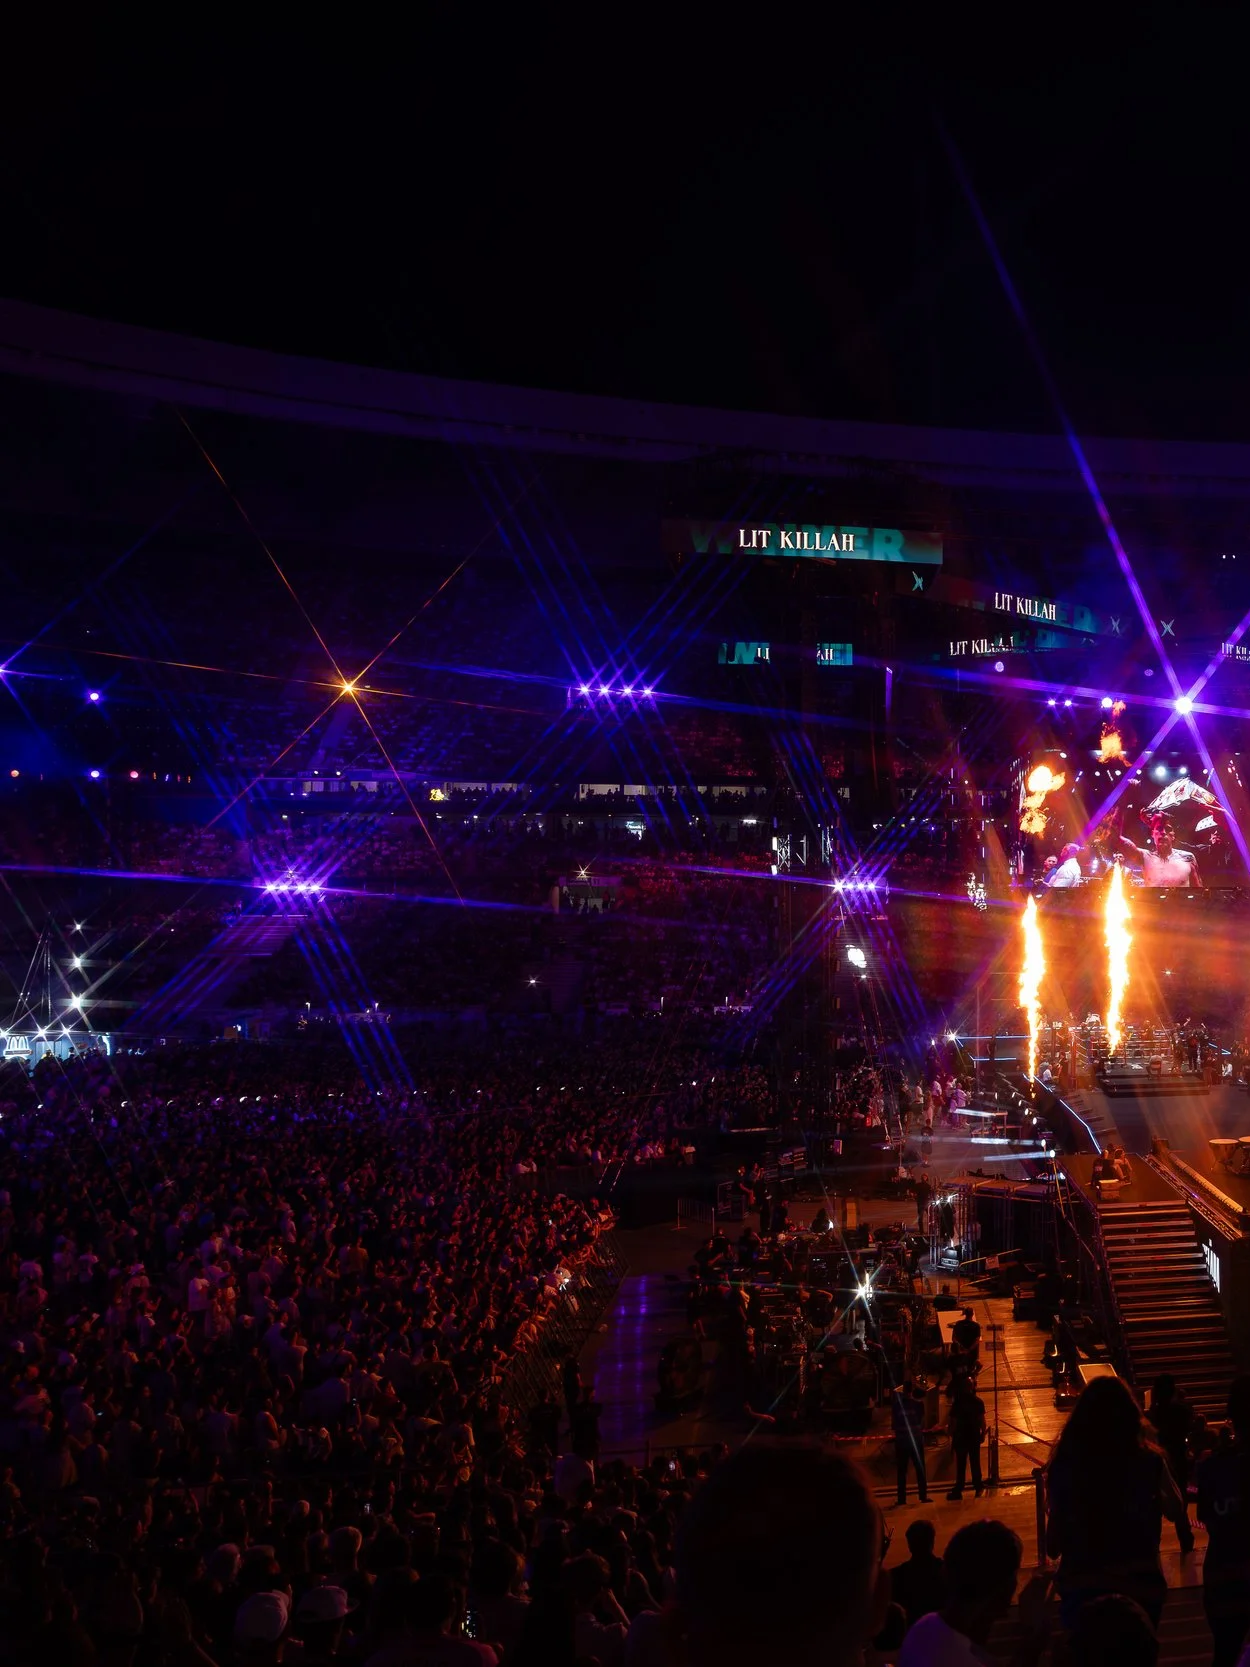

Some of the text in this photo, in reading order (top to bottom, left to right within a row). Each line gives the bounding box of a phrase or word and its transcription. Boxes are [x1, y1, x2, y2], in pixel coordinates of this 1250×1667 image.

[739, 529, 855, 552] LIT KILLAH
[994, 592, 1057, 621] LIT KILLAH
[949, 640, 968, 656] LIT
